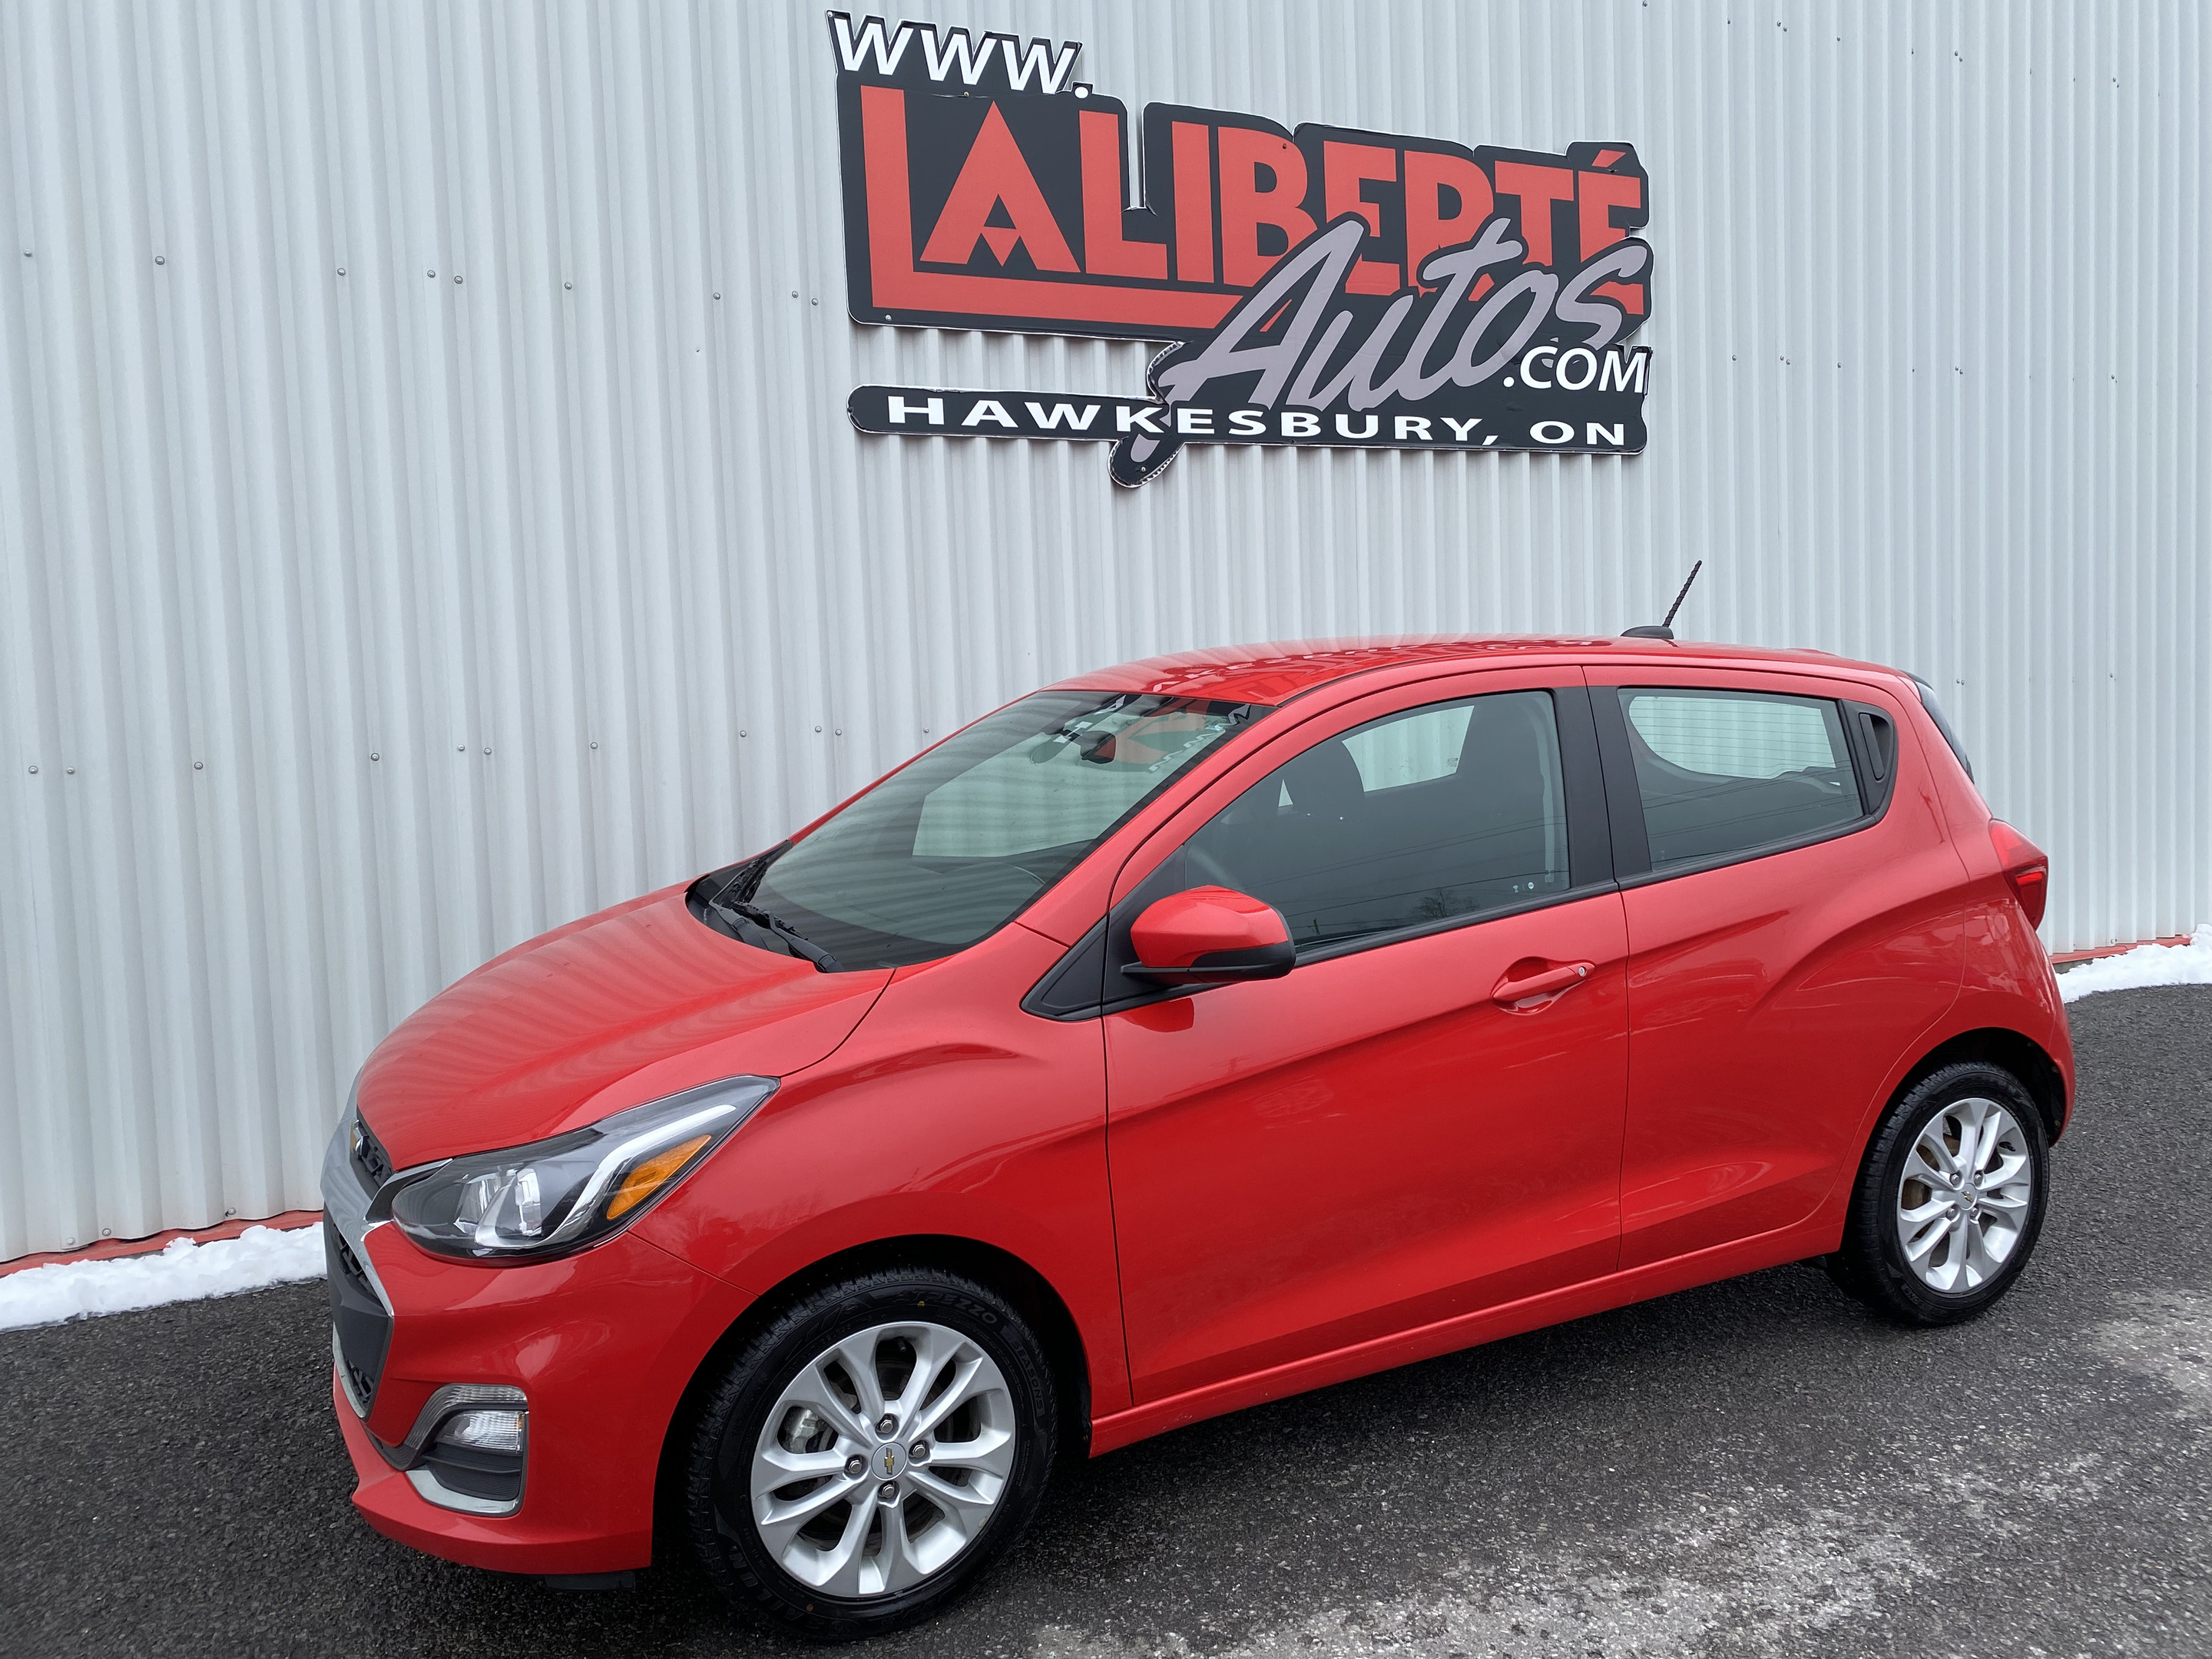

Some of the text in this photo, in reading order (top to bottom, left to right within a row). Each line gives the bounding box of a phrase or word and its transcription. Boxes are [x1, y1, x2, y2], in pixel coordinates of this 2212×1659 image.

[860, 84, 1645, 329] LALIBERTÉ
[888, 396, 1625, 447] HAWKESBURY, ON
[1131, 218, 1648, 463] Autos
